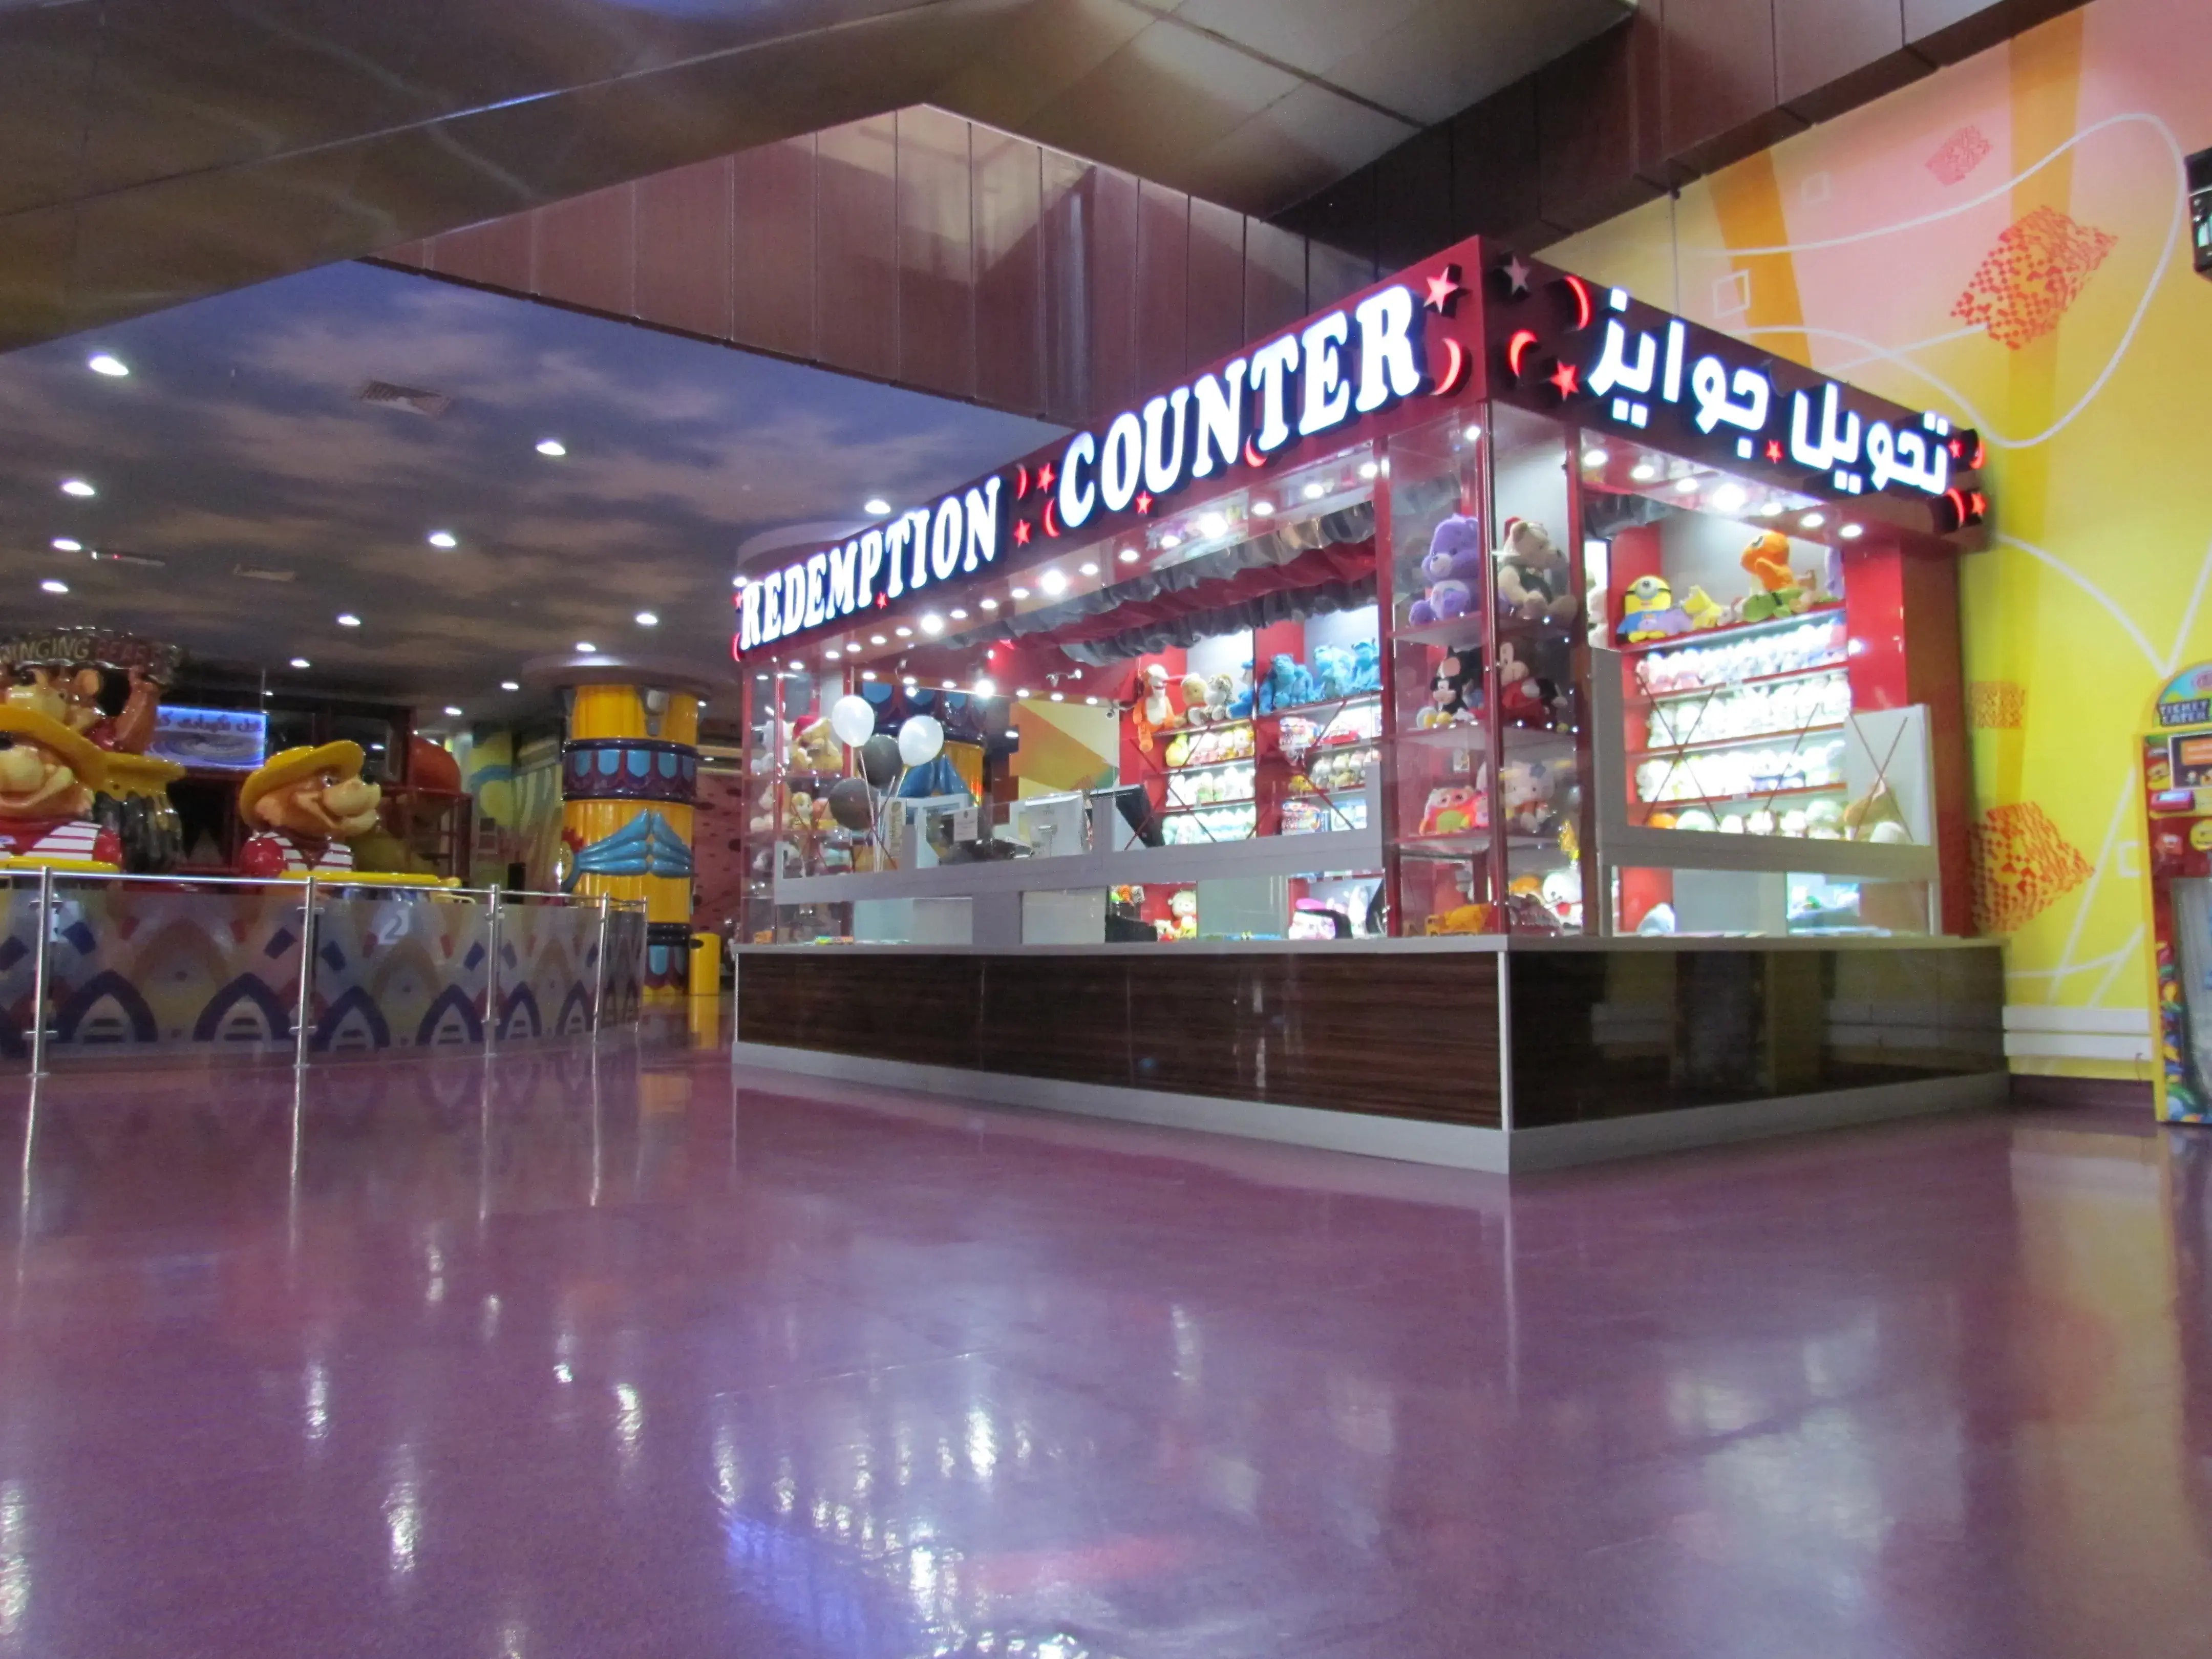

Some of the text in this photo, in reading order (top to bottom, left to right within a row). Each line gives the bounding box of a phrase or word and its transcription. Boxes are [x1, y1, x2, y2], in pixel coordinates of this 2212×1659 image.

[739, 284, 1421, 651] REDEMPTION COUNTER
[1587, 286, 1950, 495] تحويل جوايز
